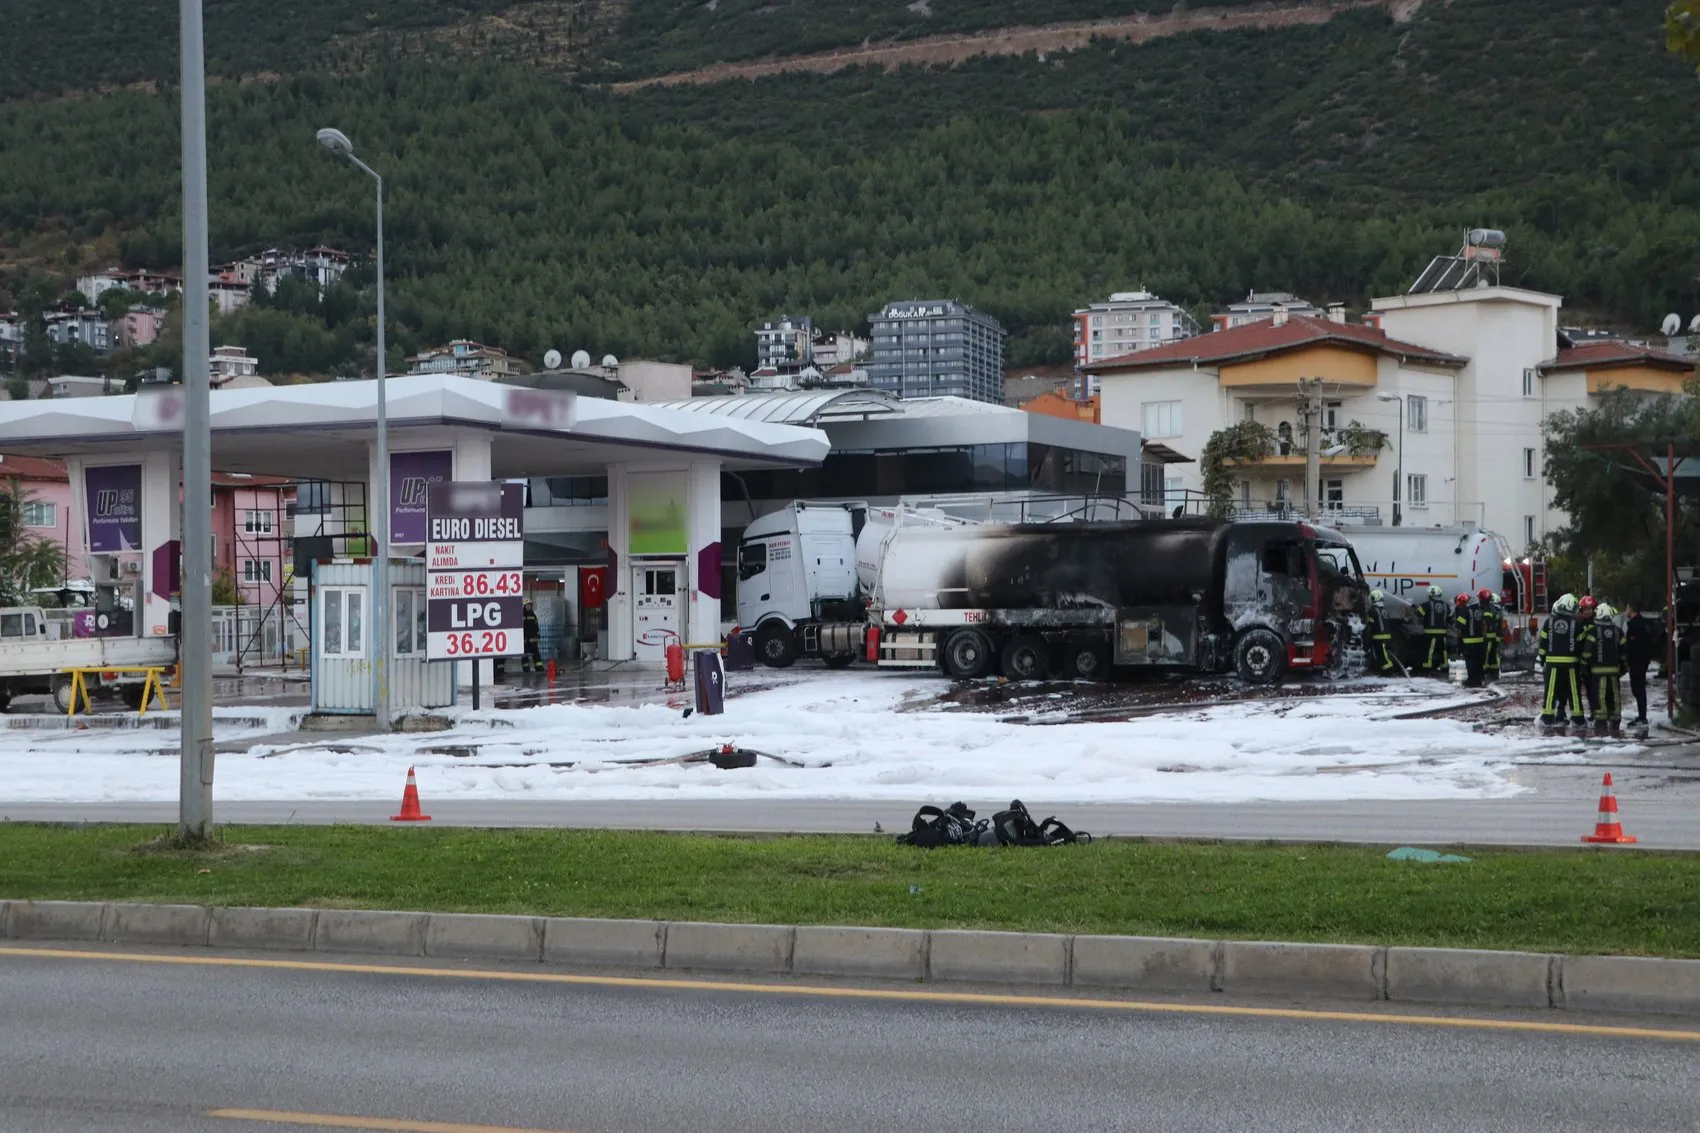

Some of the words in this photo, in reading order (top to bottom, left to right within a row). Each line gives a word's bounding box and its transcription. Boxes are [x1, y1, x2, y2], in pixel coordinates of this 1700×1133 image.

[400, 476, 426, 506] UP
[96, 489, 118, 516] UP
[432, 518, 470, 540] EURO
[475, 517, 521, 539] DIESEL
[435, 545, 455, 555] NAKİT
[432, 557, 459, 567] ALIMDA
[435, 575, 455, 585] KREDİ
[463, 573, 521, 595] 86.43
[430, 586, 460, 597] KARTINA
[450, 602, 502, 628] LPG
[446, 631, 507, 655] 36.20
